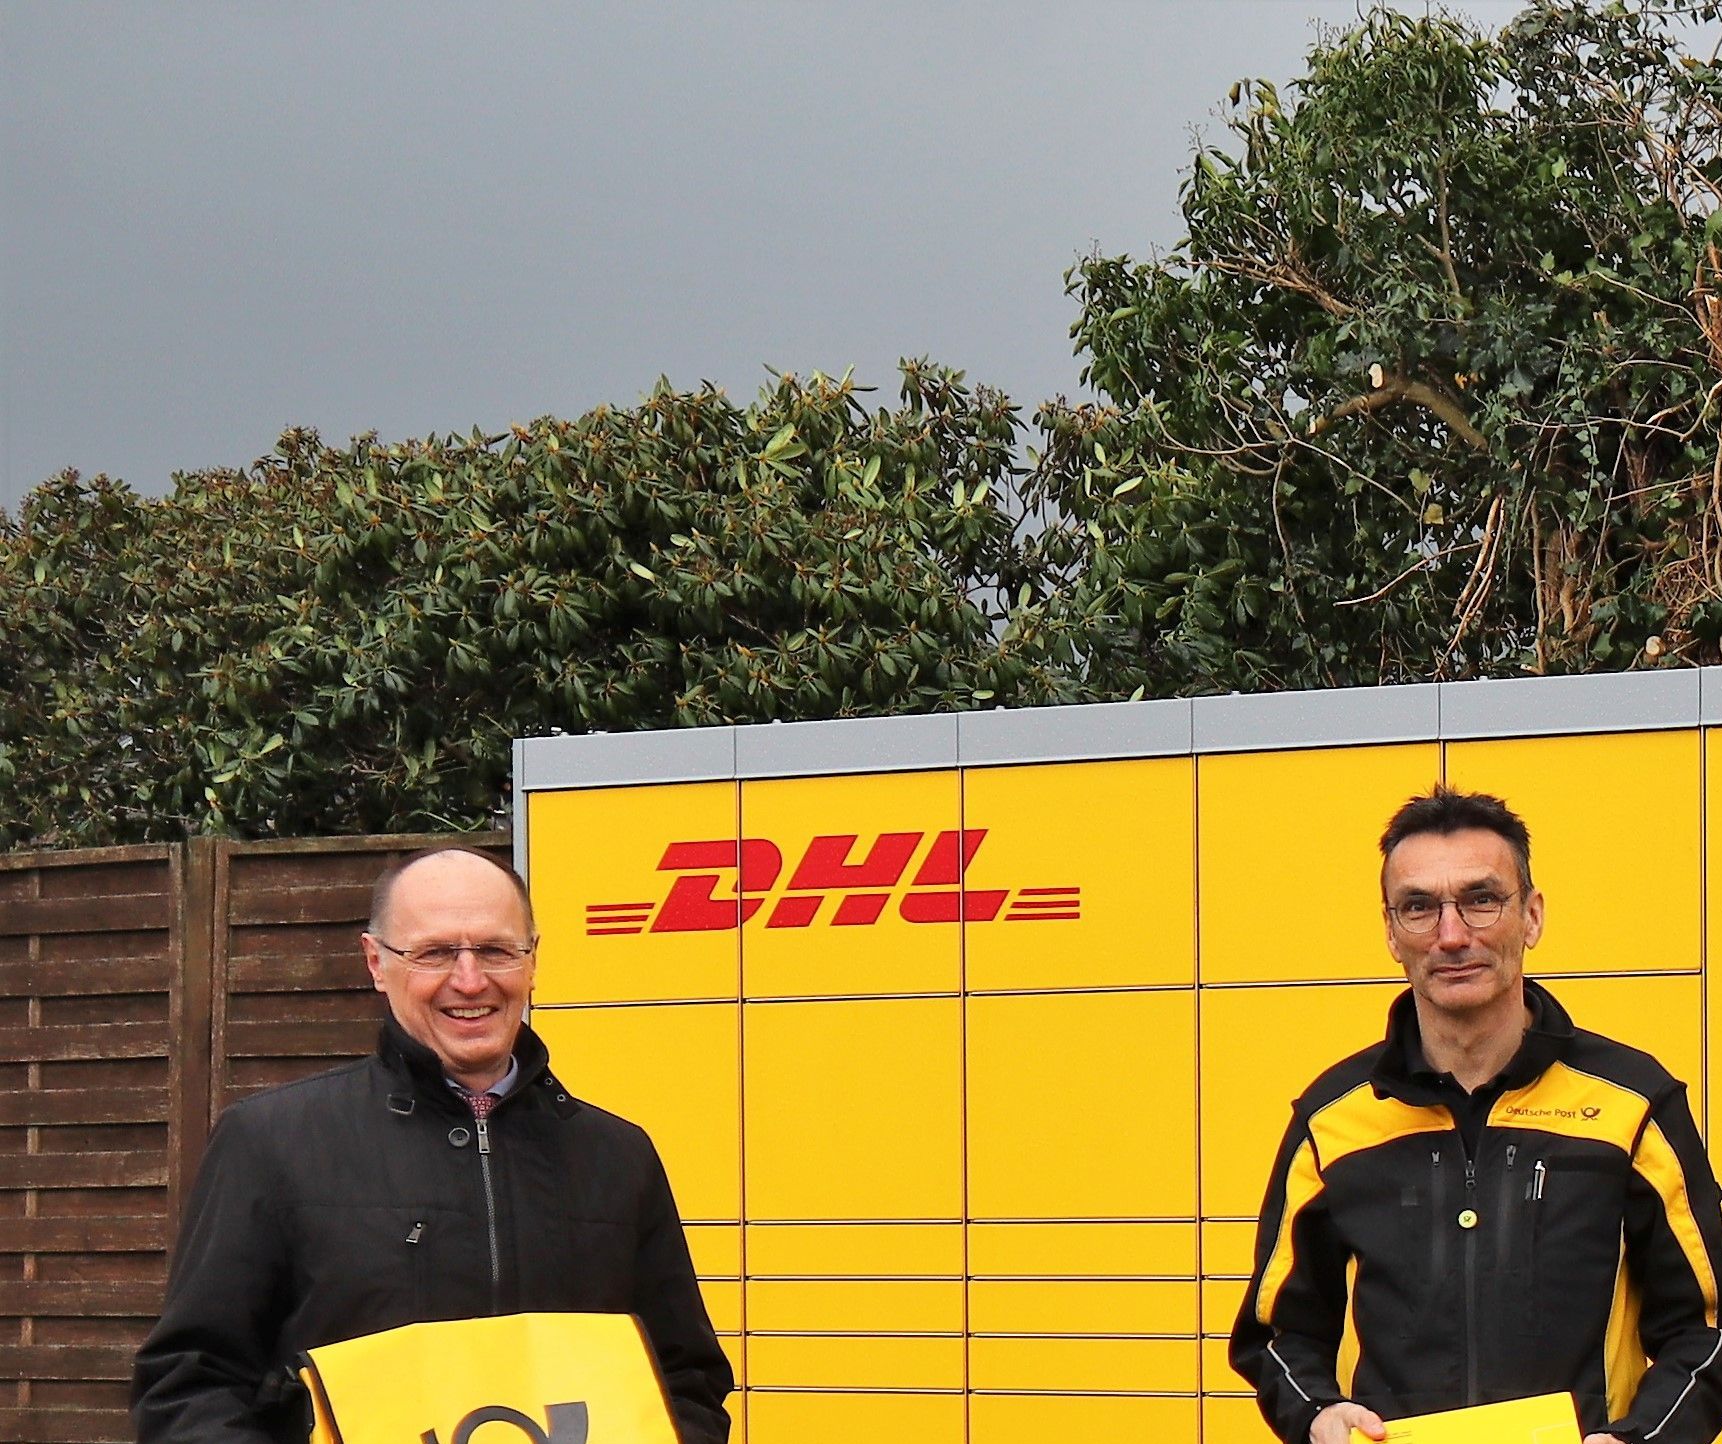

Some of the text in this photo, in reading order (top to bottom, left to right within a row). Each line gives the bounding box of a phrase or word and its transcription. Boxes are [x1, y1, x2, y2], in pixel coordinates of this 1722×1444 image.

[649, 828, 1010, 934] DHL
[1505, 1105, 1577, 1119] Deutsche Post
